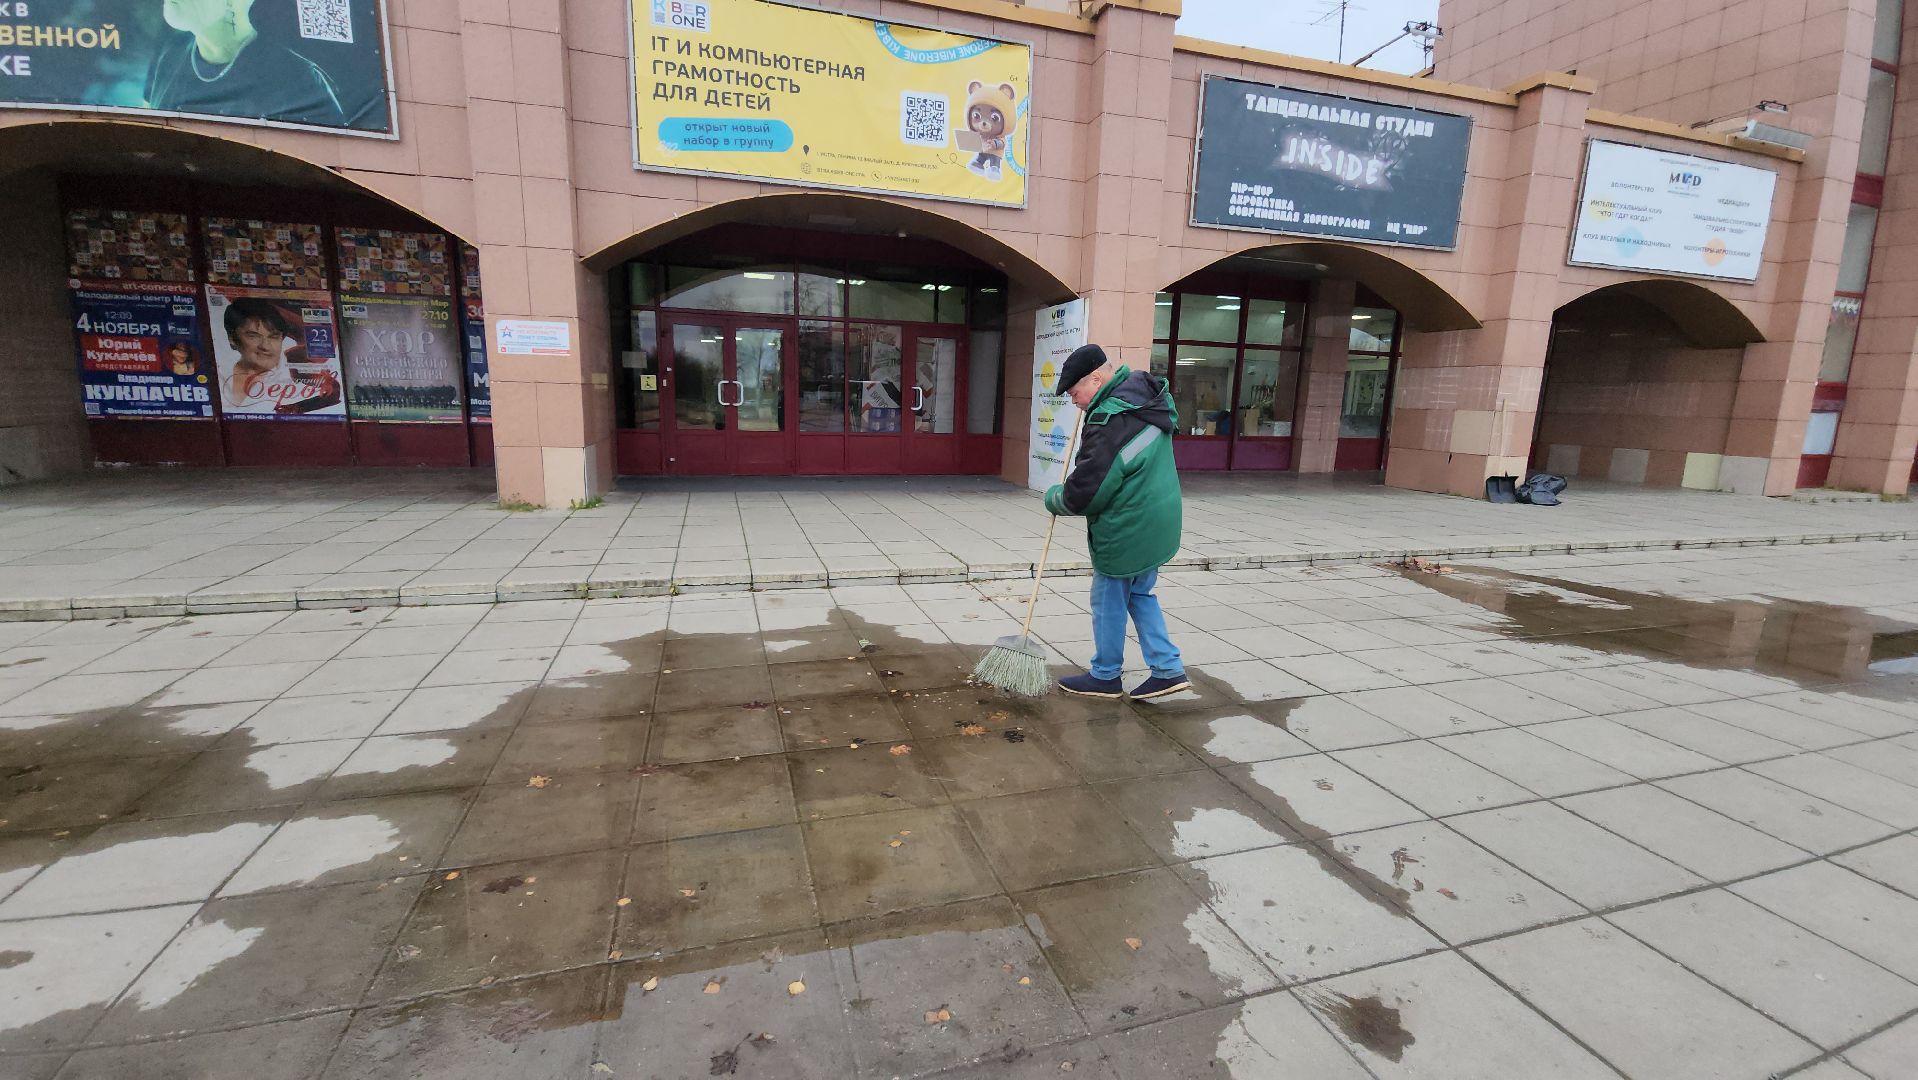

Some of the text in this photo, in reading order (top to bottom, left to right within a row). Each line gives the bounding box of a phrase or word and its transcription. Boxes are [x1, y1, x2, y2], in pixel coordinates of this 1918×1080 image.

[15, 2, 29, 17] В
[671, 14, 707, 30] ONE
[651, 35, 865, 82] IT И КОМПЬЮТЕРНАЯ
[904, 50, 957, 63] KIBERONE
[652, 59, 801, 94] ГРАМОТНОСТЬ
[652, 82, 771, 111] ДЛЯ ДЕТЕЙ
[1245, 93, 1435, 138] ТАНЦЕВАЛЬНАЯ СТУДИЯ
[684, 123, 770, 133] открыт новый
[683, 136, 774, 149] набор в группу
[1286, 137, 1380, 185] INSIDE
[1230, 182, 1274, 197] HIP-HOP
[1229, 193, 1295, 212] АКРОБАТИКА
[1228, 205, 1371, 230] СОВРЕМЕННАЯ ХОРЕОГРАФИЯ
[173, 295, 194, 304] Мир
[77, 312, 162, 336] 4 НОЯБРЯ
[311, 328, 329, 342] 23
[98, 338, 142, 351] Юрий
[84, 383, 210, 402] КУКЛАЧЁВ
